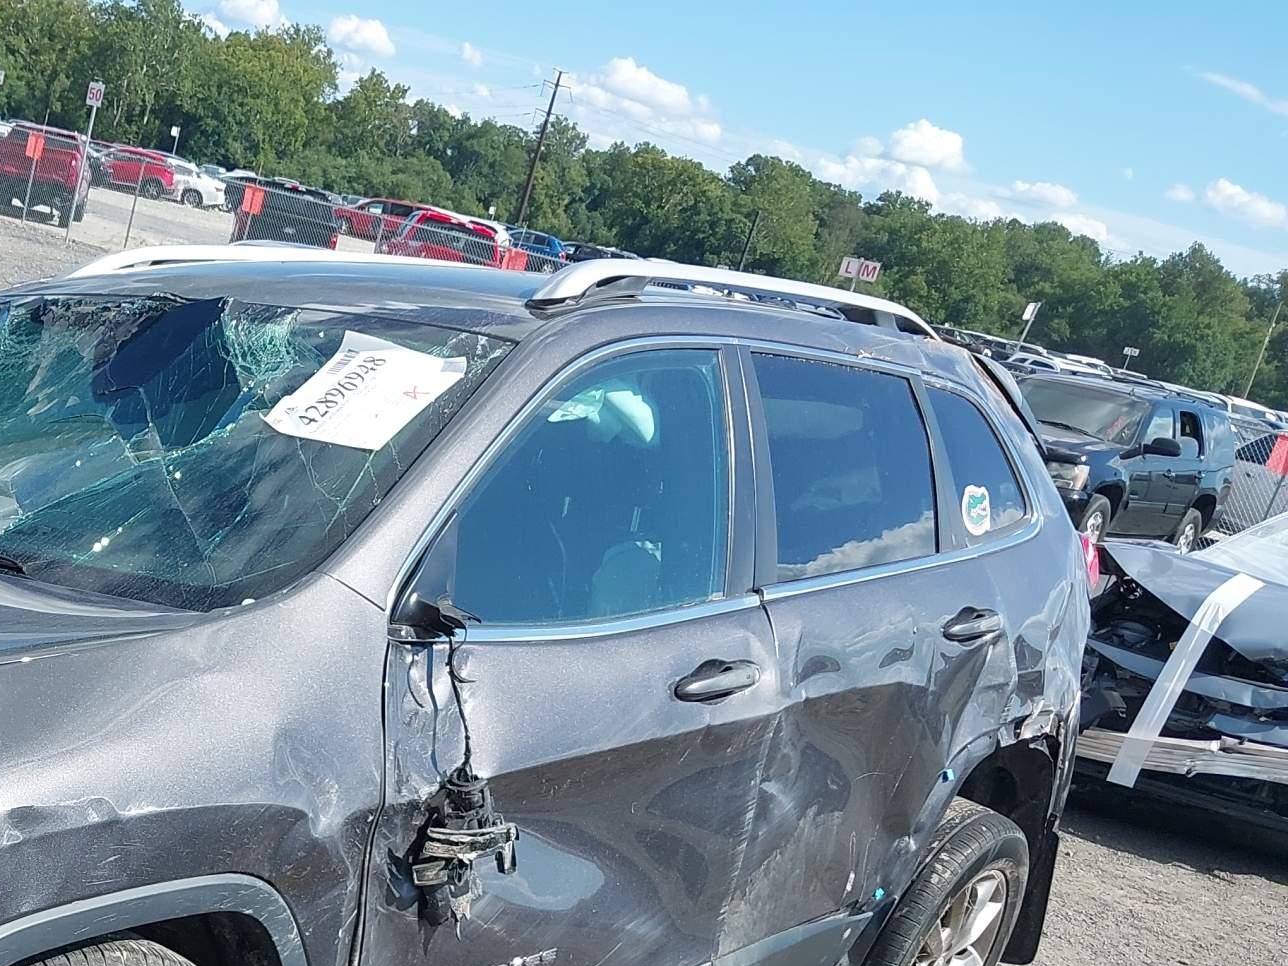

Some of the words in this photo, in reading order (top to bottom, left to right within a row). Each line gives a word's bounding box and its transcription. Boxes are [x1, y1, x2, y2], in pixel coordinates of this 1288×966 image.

[88, 86, 102, 102] 50
[844, 261, 852, 274] L
[861, 263, 878, 279] M
[298, 355, 387, 427] 42896948
